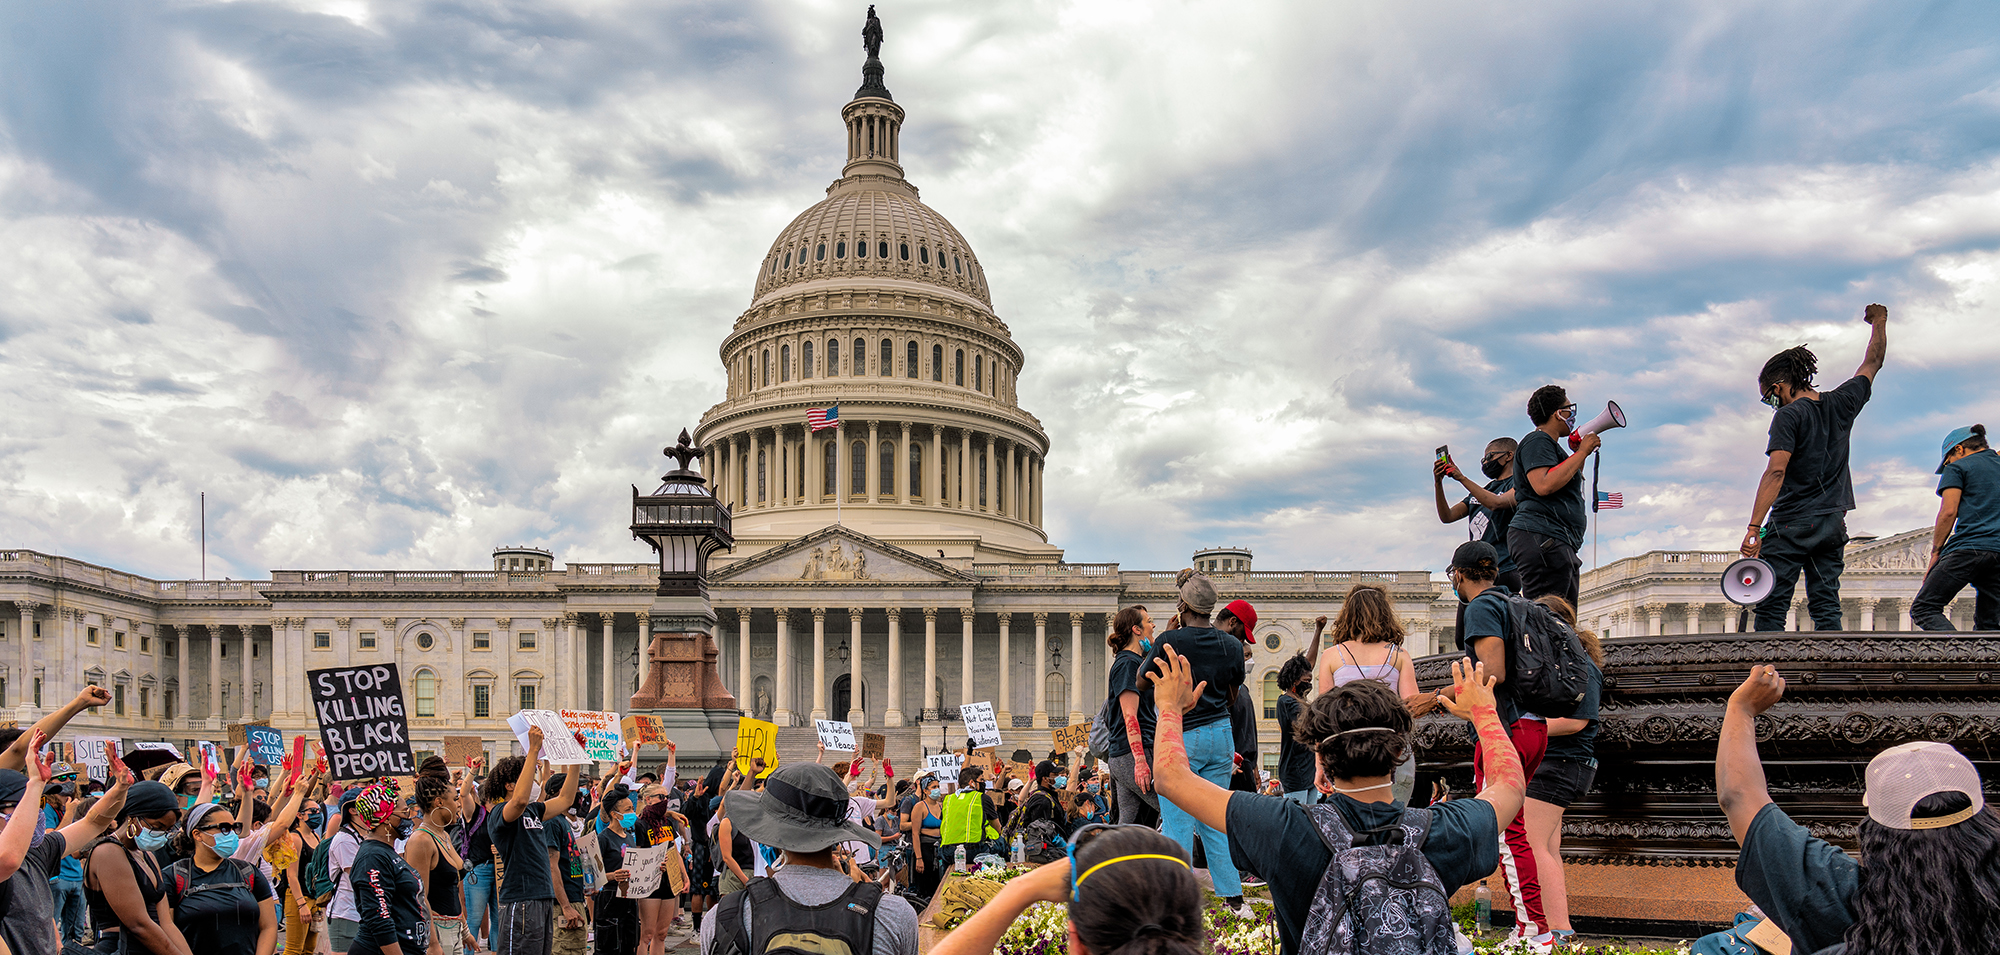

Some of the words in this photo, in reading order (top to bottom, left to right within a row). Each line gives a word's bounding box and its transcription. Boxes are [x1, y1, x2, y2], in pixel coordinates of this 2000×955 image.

[317, 666, 390, 697] STOP
[317, 695, 404, 725] KILLING
[963, 706, 972, 714] If
[636, 716, 657, 726] SPEAK
[966, 715, 976, 724] Not
[817, 721, 829, 733] No
[985, 723, 996, 732] Not
[1055, 722, 1093, 743] BLAC
[251, 730, 281, 746] STOP
[326, 721, 404, 752] BLACK
[820, 735, 832, 748] No
[833, 735, 855, 750] Peace
[1062, 734, 1086, 747] LIVES
[78, 739, 122, 759] SILENE
[257, 745, 286, 757] KILLING
[100, 754, 108, 764] IS
[333, 750, 415, 777] PEOPLE.
[930, 757, 939, 767] If
[941, 756, 953, 767] Not
[624, 851, 638, 866] If
